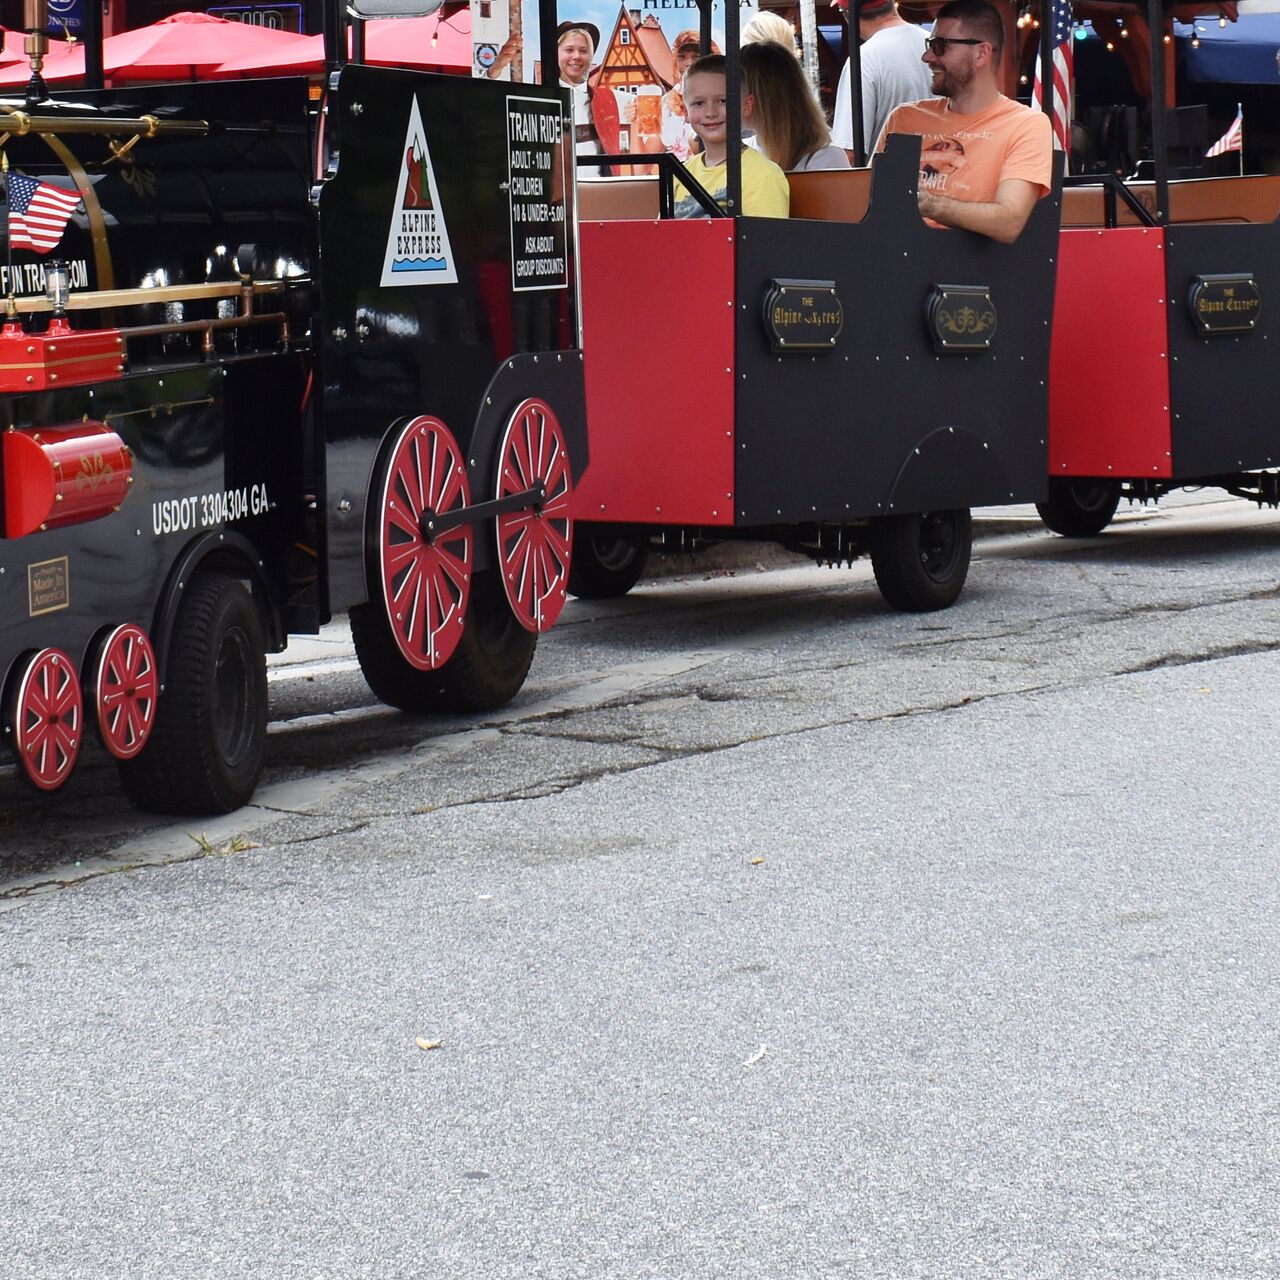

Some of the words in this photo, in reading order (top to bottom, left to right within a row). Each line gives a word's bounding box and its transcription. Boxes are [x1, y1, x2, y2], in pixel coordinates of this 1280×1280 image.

[509, 112, 538, 142] TRAIN
[540, 114, 561, 144] RIDE
[511, 150, 531, 169] ADULT
[536, 151, 551, 170] 10.00
[512, 177, 543, 196] CHILDREN
[513, 204, 520, 222] 10
[521, 204, 527, 222] &
[402, 214, 436, 233] ALPINE
[397, 236, 441, 255] EXPRESS
[525, 237, 537, 254] ASK
[536, 236, 554, 253] ABOUT
[516, 260, 535, 277] GROUP
[535, 258, 564, 275] DISCOUNTS
[153, 496, 198, 535] USDOT
[201, 487, 248, 526] 3304304
[251, 483, 269, 516] GA
